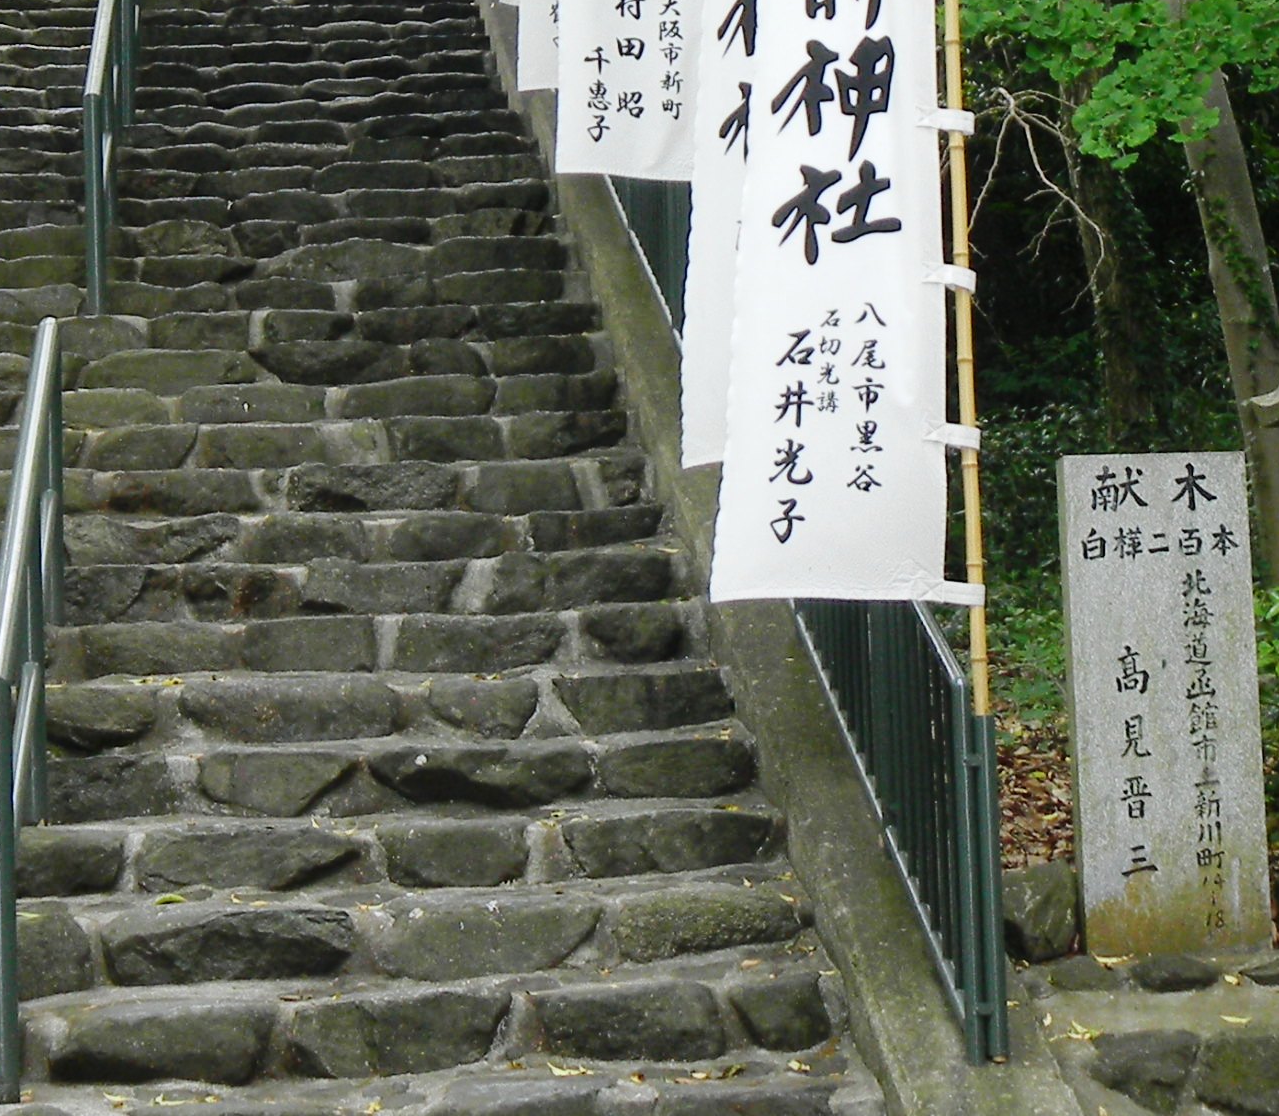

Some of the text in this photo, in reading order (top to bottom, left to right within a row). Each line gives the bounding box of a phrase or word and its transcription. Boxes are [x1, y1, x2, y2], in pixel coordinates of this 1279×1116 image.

[768, 328, 816, 545] 石井光子
[816, 308, 843, 414] 石切光講
[846, 301, 888, 493] 八尾市黒谷
